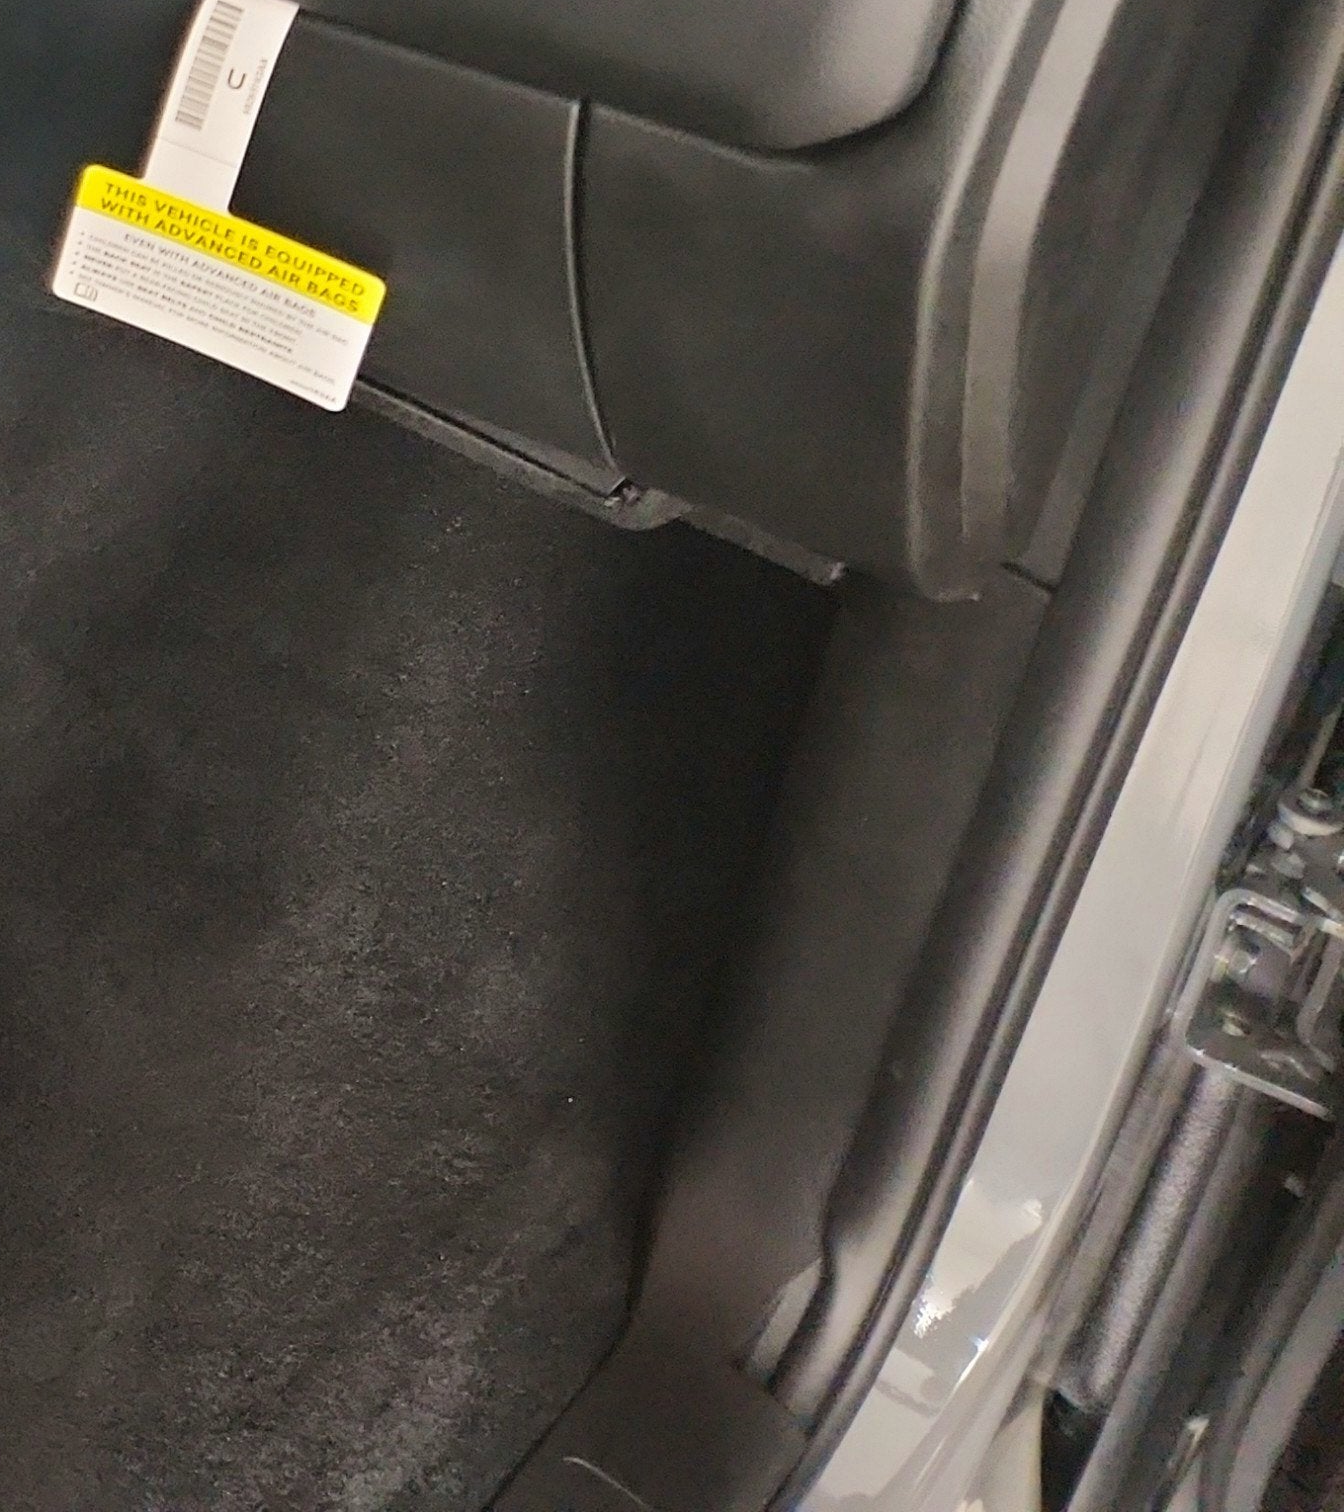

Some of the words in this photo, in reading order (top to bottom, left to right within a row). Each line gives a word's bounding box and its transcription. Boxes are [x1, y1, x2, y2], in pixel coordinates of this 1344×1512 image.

[228, 68, 246, 90] U
[99, 197, 150, 225] WITH
[154, 219, 263, 270] ADVANCED
[267, 265, 301, 286] AIR
[305, 281, 360, 312] BAGS
[103, 181, 148, 208] THIS
[151, 199, 238, 242] VEHICLE
[239, 235, 260, 252] IS
[263, 245, 367, 296] EQUIPPED
[124, 233, 155, 251] EVEN
[157, 246, 189, 265] WITH
[191, 260, 258, 292] ADVANCED
[261, 288, 282, 302] AIR
